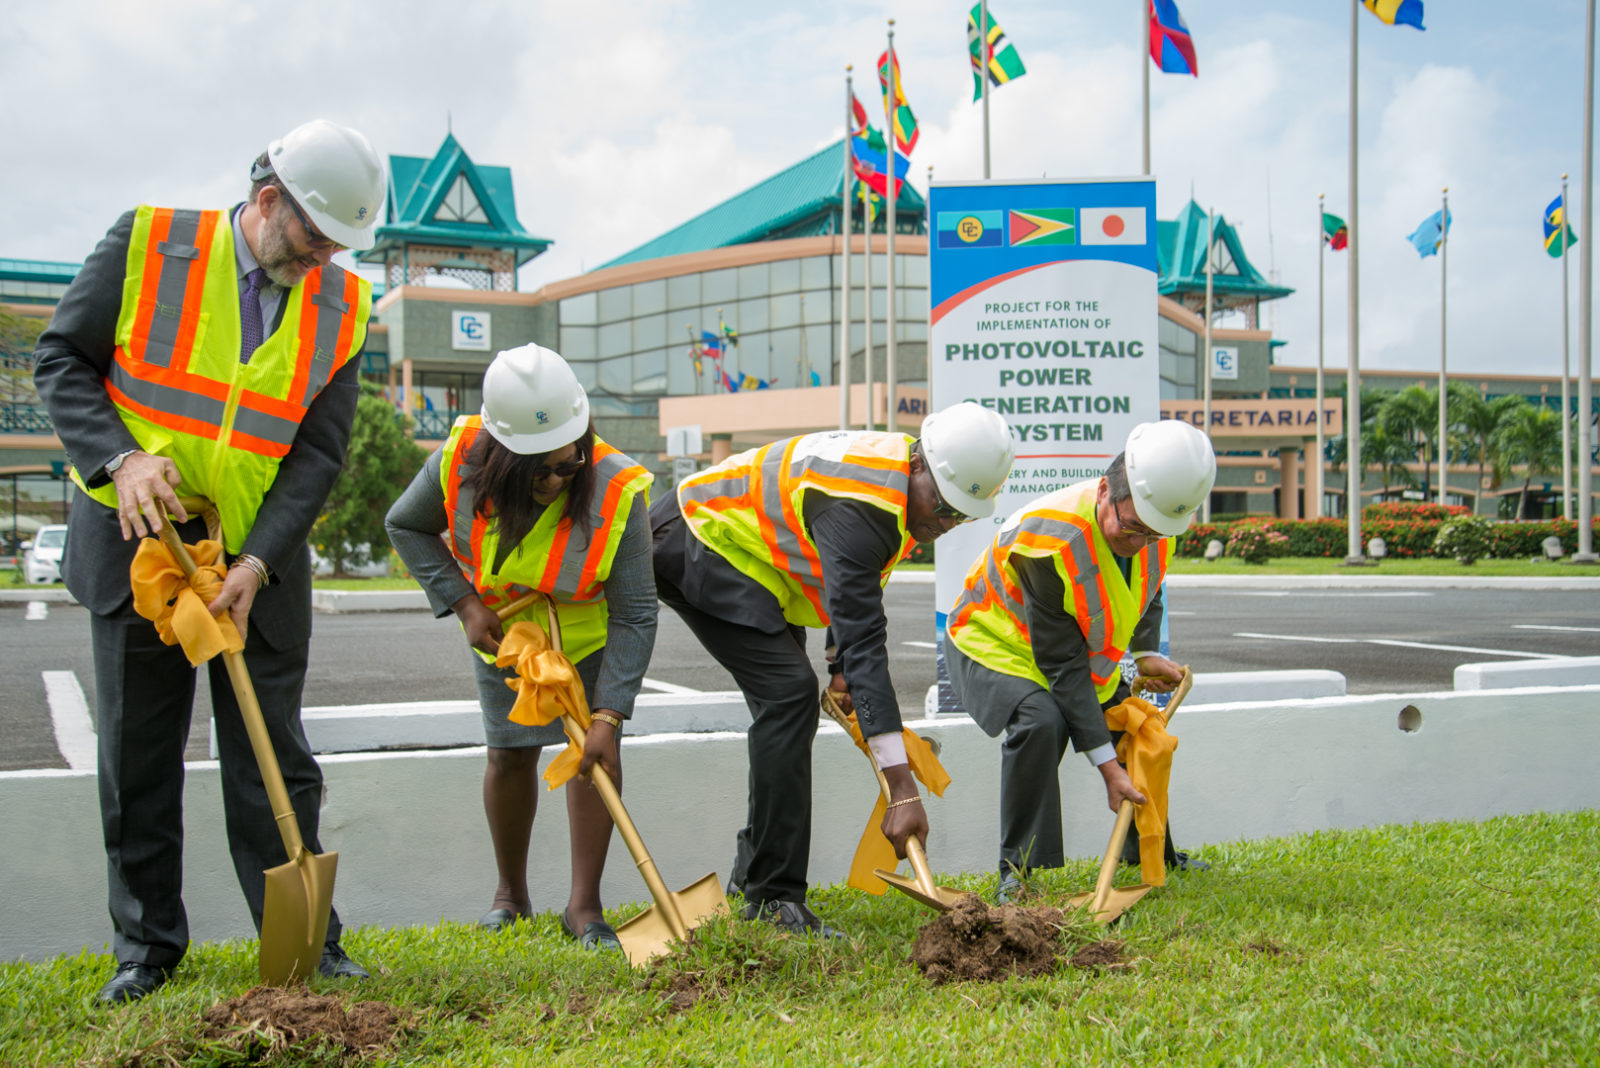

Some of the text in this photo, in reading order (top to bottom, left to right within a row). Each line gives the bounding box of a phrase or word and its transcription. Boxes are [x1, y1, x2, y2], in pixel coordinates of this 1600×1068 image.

[985, 300, 1099, 313] PROJECT FOR THE
[977, 318, 1111, 331] IMPLEMENTATION OF
[945, 340, 1144, 361] PHOTOVOLTAIC
[1000, 368, 1092, 387] POWER
[884, 396, 928, 416] ARI
[962, 396, 1130, 414] ENERATION
[1008, 468, 1105, 479] ERY AND BUILDIN
